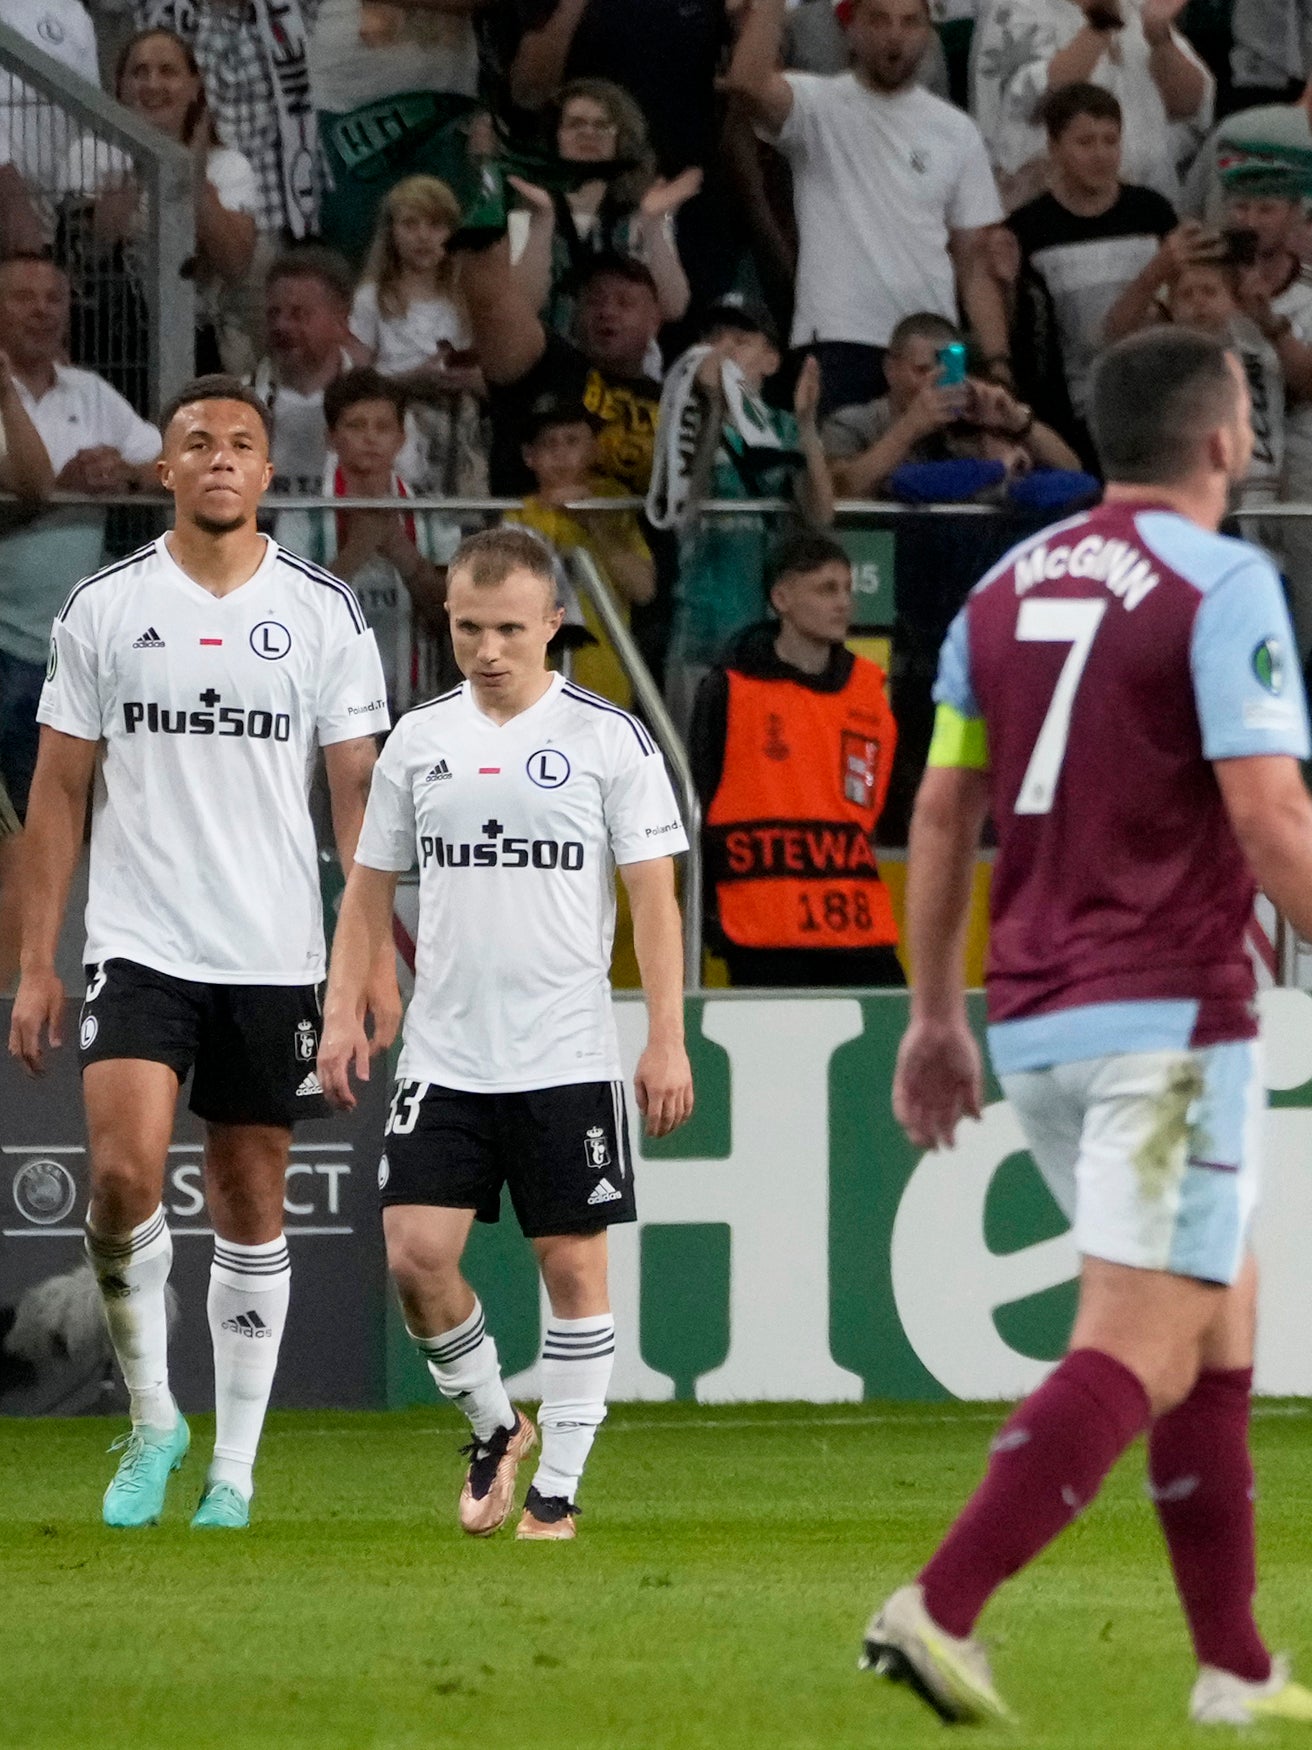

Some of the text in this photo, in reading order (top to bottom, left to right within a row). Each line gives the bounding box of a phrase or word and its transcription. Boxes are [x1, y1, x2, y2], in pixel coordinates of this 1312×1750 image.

[123, 702, 290, 742] Plus500
[1014, 598, 1108, 813] 7
[420, 836, 584, 871] Plus500
[799, 889, 873, 932] 188
[221, 1321, 272, 1339] adidas
